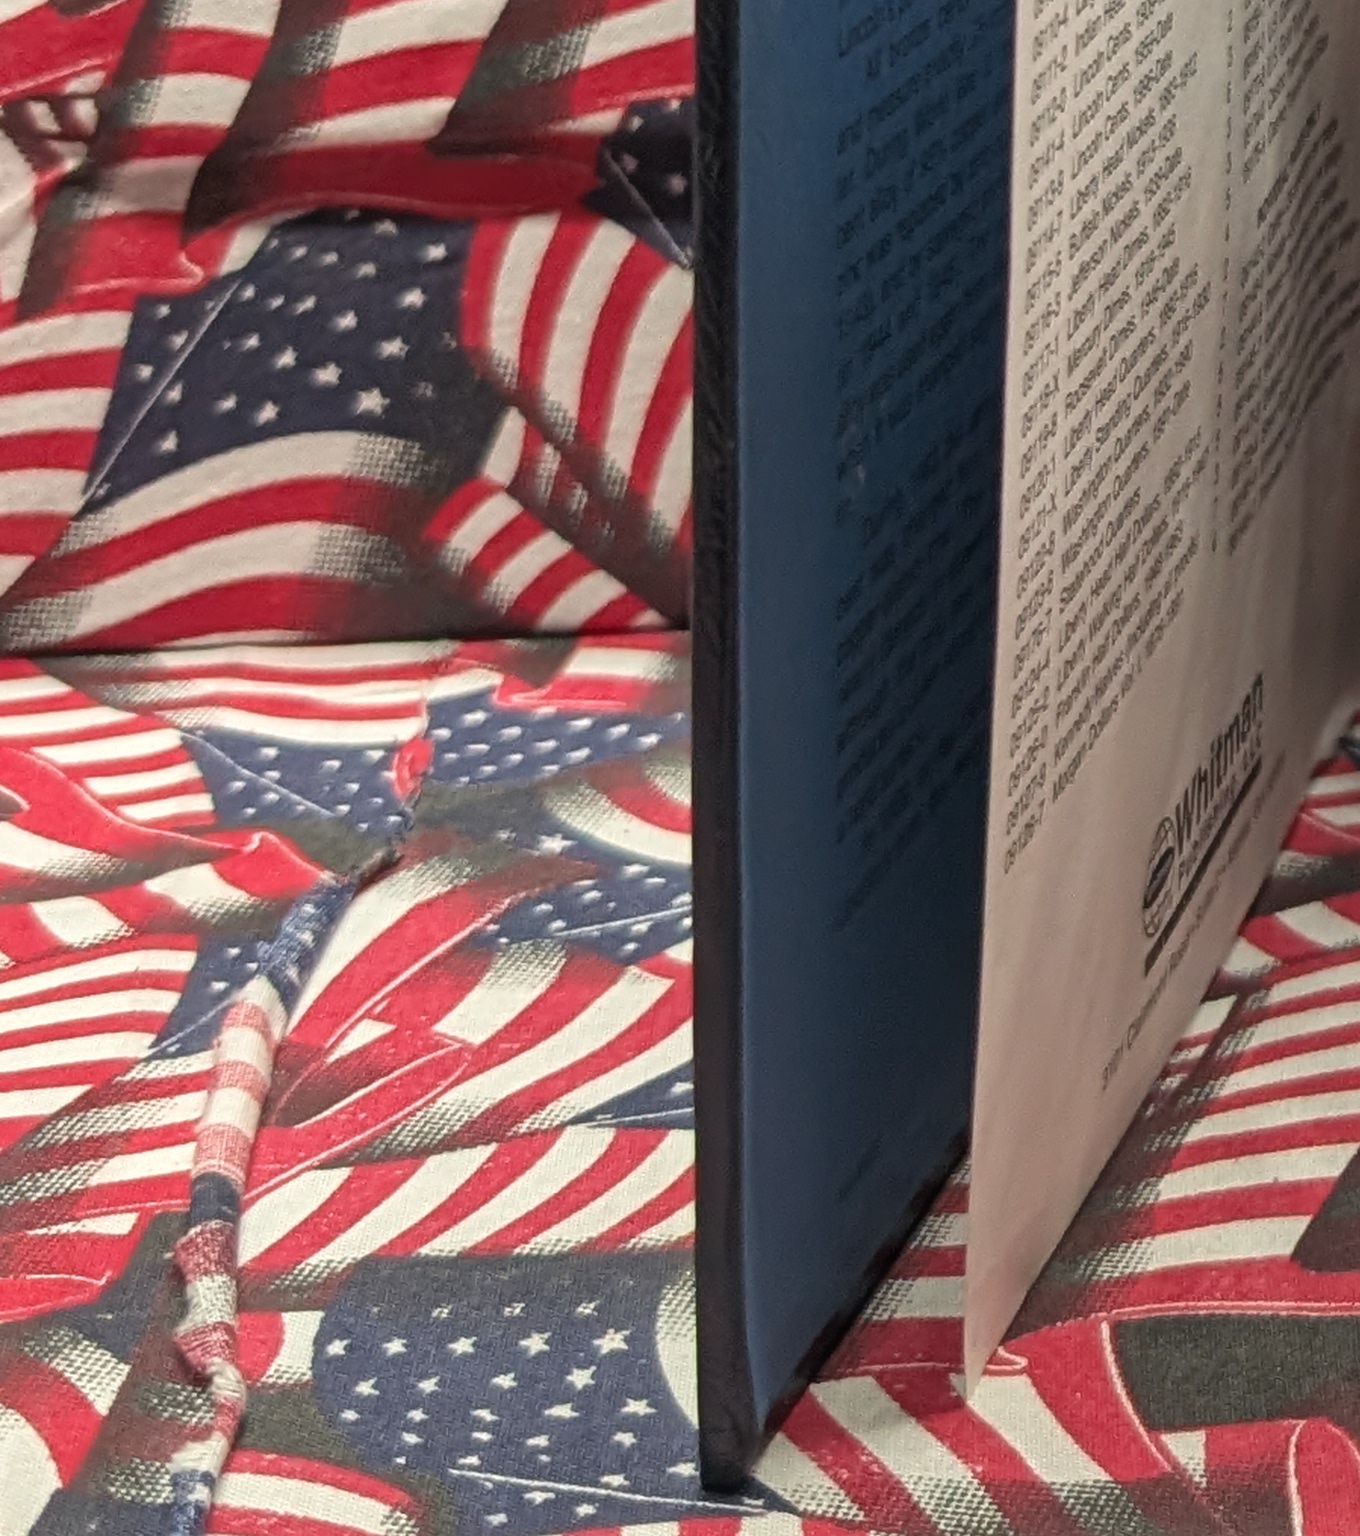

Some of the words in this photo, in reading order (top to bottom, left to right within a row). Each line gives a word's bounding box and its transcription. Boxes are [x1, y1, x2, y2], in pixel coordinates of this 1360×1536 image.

[1072, 91, 1102, 140] Lincoln
[1106, 60, 1129, 102] Cents
[1074, 50, 1104, 99] Lincoln
[1106, 22, 1131, 62] Cents
[1071, 131, 1102, 180] Lincoln
[1104, 100, 1128, 142] Cents
[1067, 291, 1094, 342] Liberty
[1122, 225, 1148, 271] Dimes
[1068, 237, 1107, 302] Jefferson
[1064, 346, 1106, 418] Roosevelt
[1108, 314, 1136, 361] Dimes
[1068, 319, 1100, 379] Mercury
[1103, 284, 1130, 333] Dimes
[1064, 408, 1091, 461] Liberty
[1095, 368, 1116, 417] Head
[1118, 325, 1155, 383] Quarters
[1095, 391, 1130, 454] Standing
[1134, 343, 1168, 401] Quarters
[1061, 492, 1110, 575] Washington
[1112, 440, 1150, 501] Quarters
[1063, 453, 1111, 536] Washington
[1114, 403, 1150, 463] Quarters
[1059, 532, 1103, 615] Statehood
[1105, 484, 1140, 547] Quarters
[1175, 671, 1263, 857] Whitman
